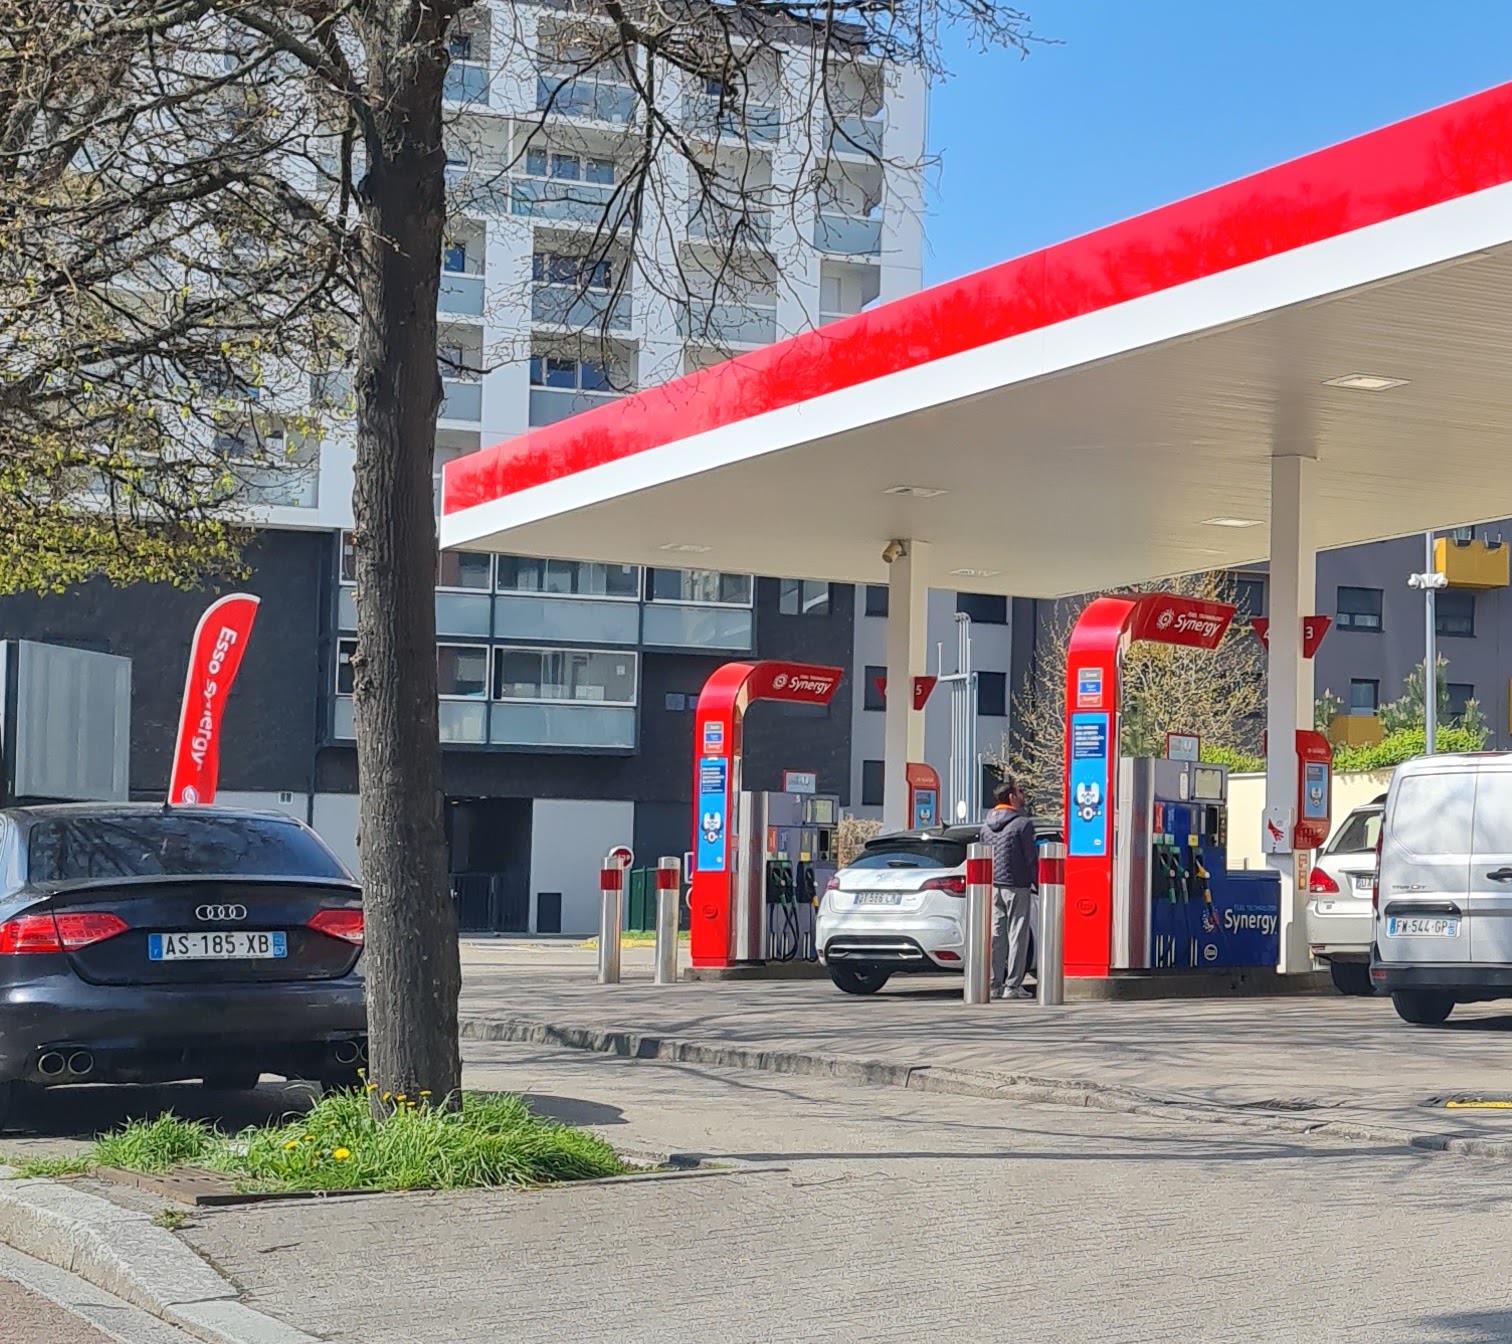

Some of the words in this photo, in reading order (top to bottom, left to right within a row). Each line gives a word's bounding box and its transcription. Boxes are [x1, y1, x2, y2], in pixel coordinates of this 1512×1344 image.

[1174, 614, 1221, 638] Synergy
[1305, 626, 1314, 640] 3
[208, 626, 238, 676] Esso
[788, 675, 832, 694] Synergy
[915, 683, 923, 696] 5
[1224, 908, 1277, 935] Synergy
[166, 934, 270, 956] AS-185-XB
